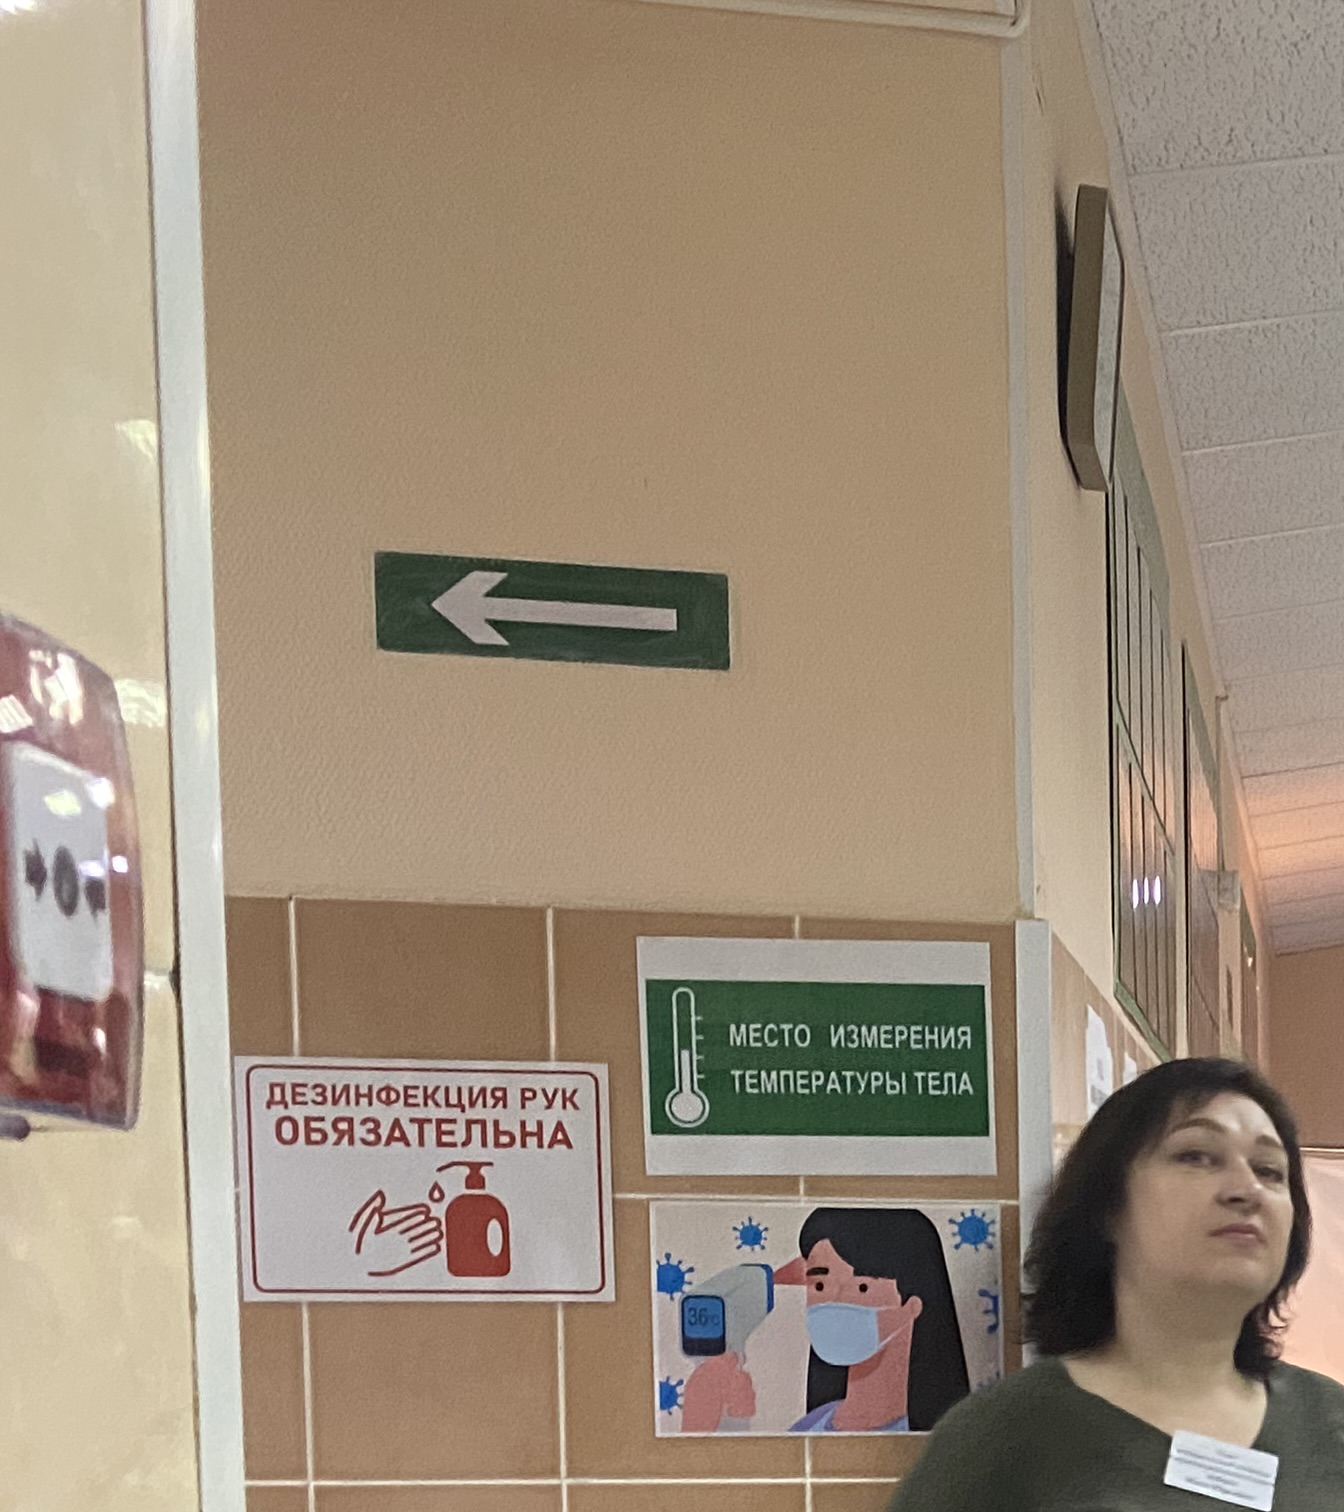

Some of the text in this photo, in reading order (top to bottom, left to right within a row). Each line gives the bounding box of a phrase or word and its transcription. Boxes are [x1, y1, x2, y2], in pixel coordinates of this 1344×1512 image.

[729, 1023, 972, 1050] МЕСТО ИЗМЕРЕНИЯ
[731, 1069, 974, 1096] ТЕМПЕРАТУРЫ ТЕЛА
[266, 1082, 580, 1113] ДЕЗИНФЕКЦИЯ РУК
[274, 1114, 573, 1150] ОБЯЗАТЕЛЬНА
